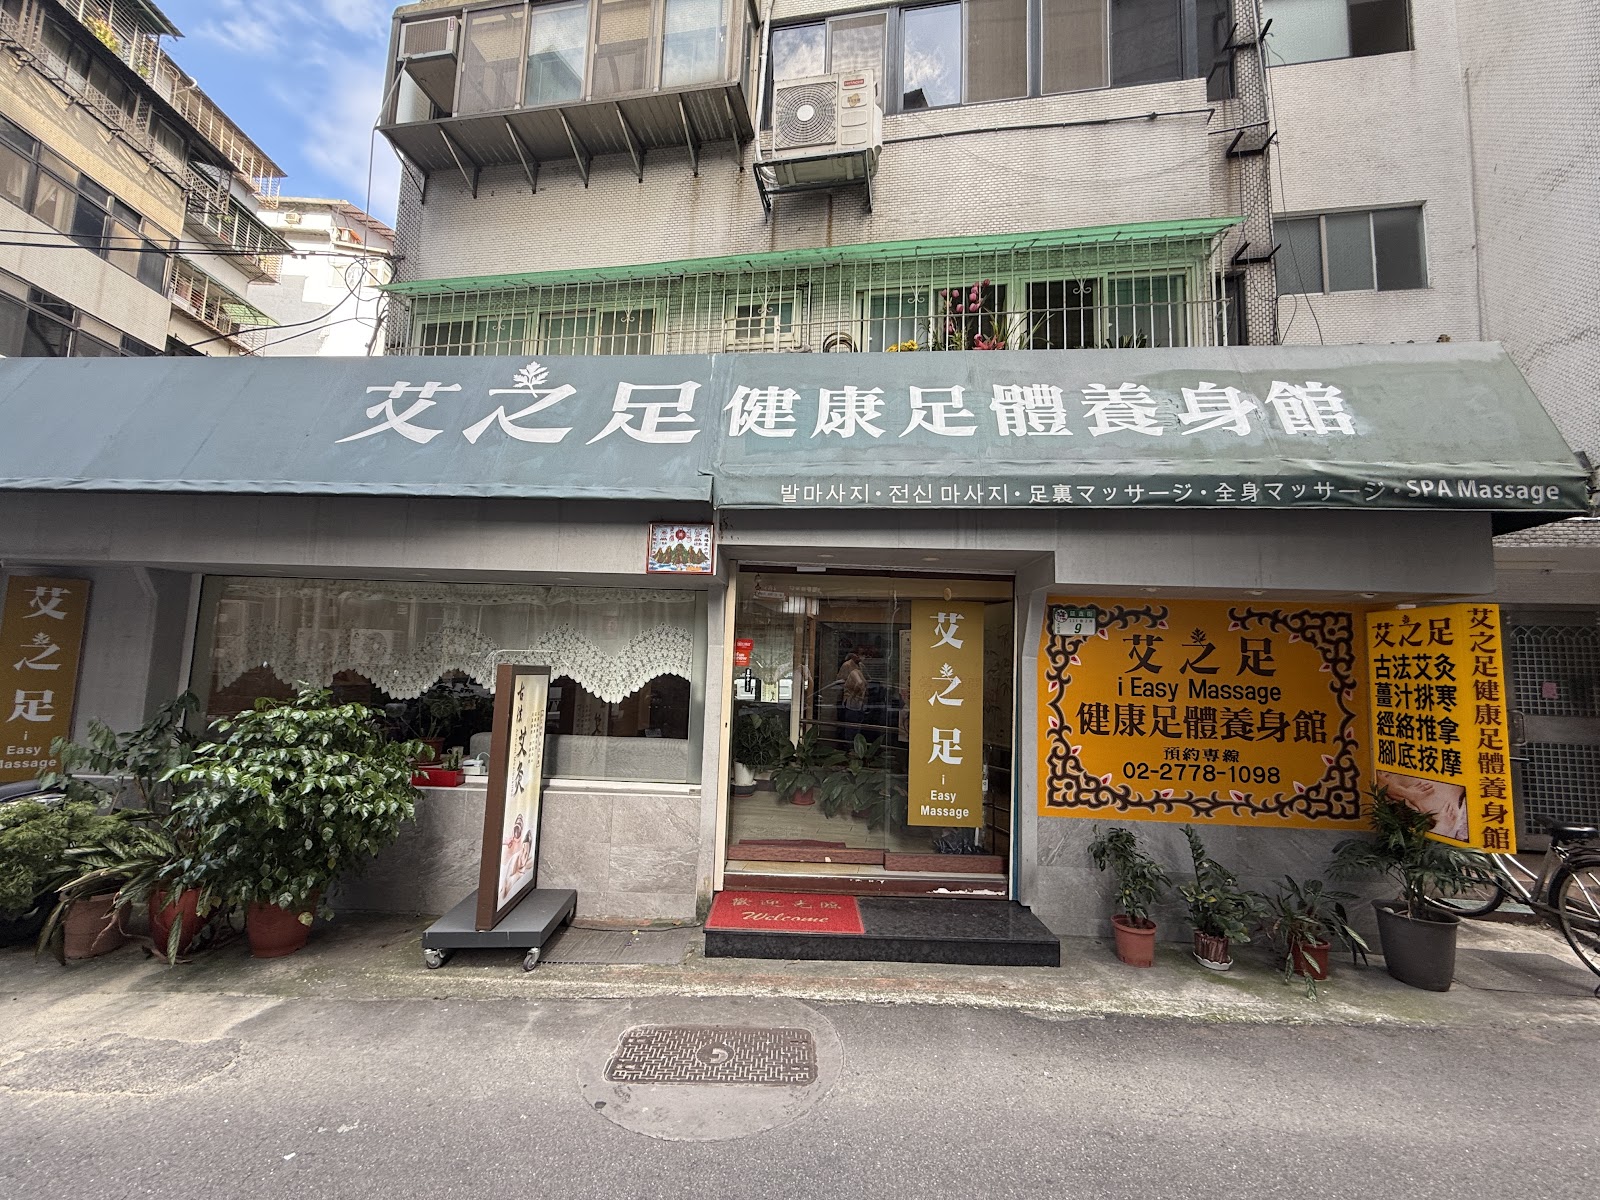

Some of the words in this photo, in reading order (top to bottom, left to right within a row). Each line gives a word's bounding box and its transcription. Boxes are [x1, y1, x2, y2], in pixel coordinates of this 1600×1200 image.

[335, 380, 702, 445] 艾之足
[722, 380, 1356, 438] 健康足體養身館
[780, 483, 869, 504] 발마사지
[889, 484, 933, 504] 전신
[941, 484, 1008, 504] 마사지
[1029, 482, 1194, 503] 足裏マッサージ
[1214, 481, 1386, 503] 全身マッサージ
[1408, 479, 1453, 498] SPA
[1457, 480, 1560, 504] Massage
[1074, 623, 1082, 634] 9
[1372, 617, 1454, 649] 艾之足
[6, 586, 71, 722] 艾之足
[1122, 633, 1277, 678] 艾之足
[1374, 653, 1456, 682] 古法艾灸
[928, 612, 964, 764] 艾之足
[1117, 677, 1123, 697] i
[1130, 677, 1179, 702] Easy
[1188, 679, 1282, 705] Massage
[1375, 682, 1458, 713] 薑汁排寒
[23, 730, 28, 741] i
[1075, 702, 1328, 744] 健康足體養身館
[1376, 711, 1461, 745] 經絡推拿
[1467, 607, 1510, 850] 艾之足健康足體養身館
[6, 745, 42, 757] Easy
[1378, 738, 1463, 777] 腳底按摩
[941, 774, 945, 785] i
[1122, 761, 1281, 784] 02-2778-1098
[930, 790, 957, 804] Easy
[920, 805, 970, 820] Massage
[741, 911, 829, 924] Welcome
